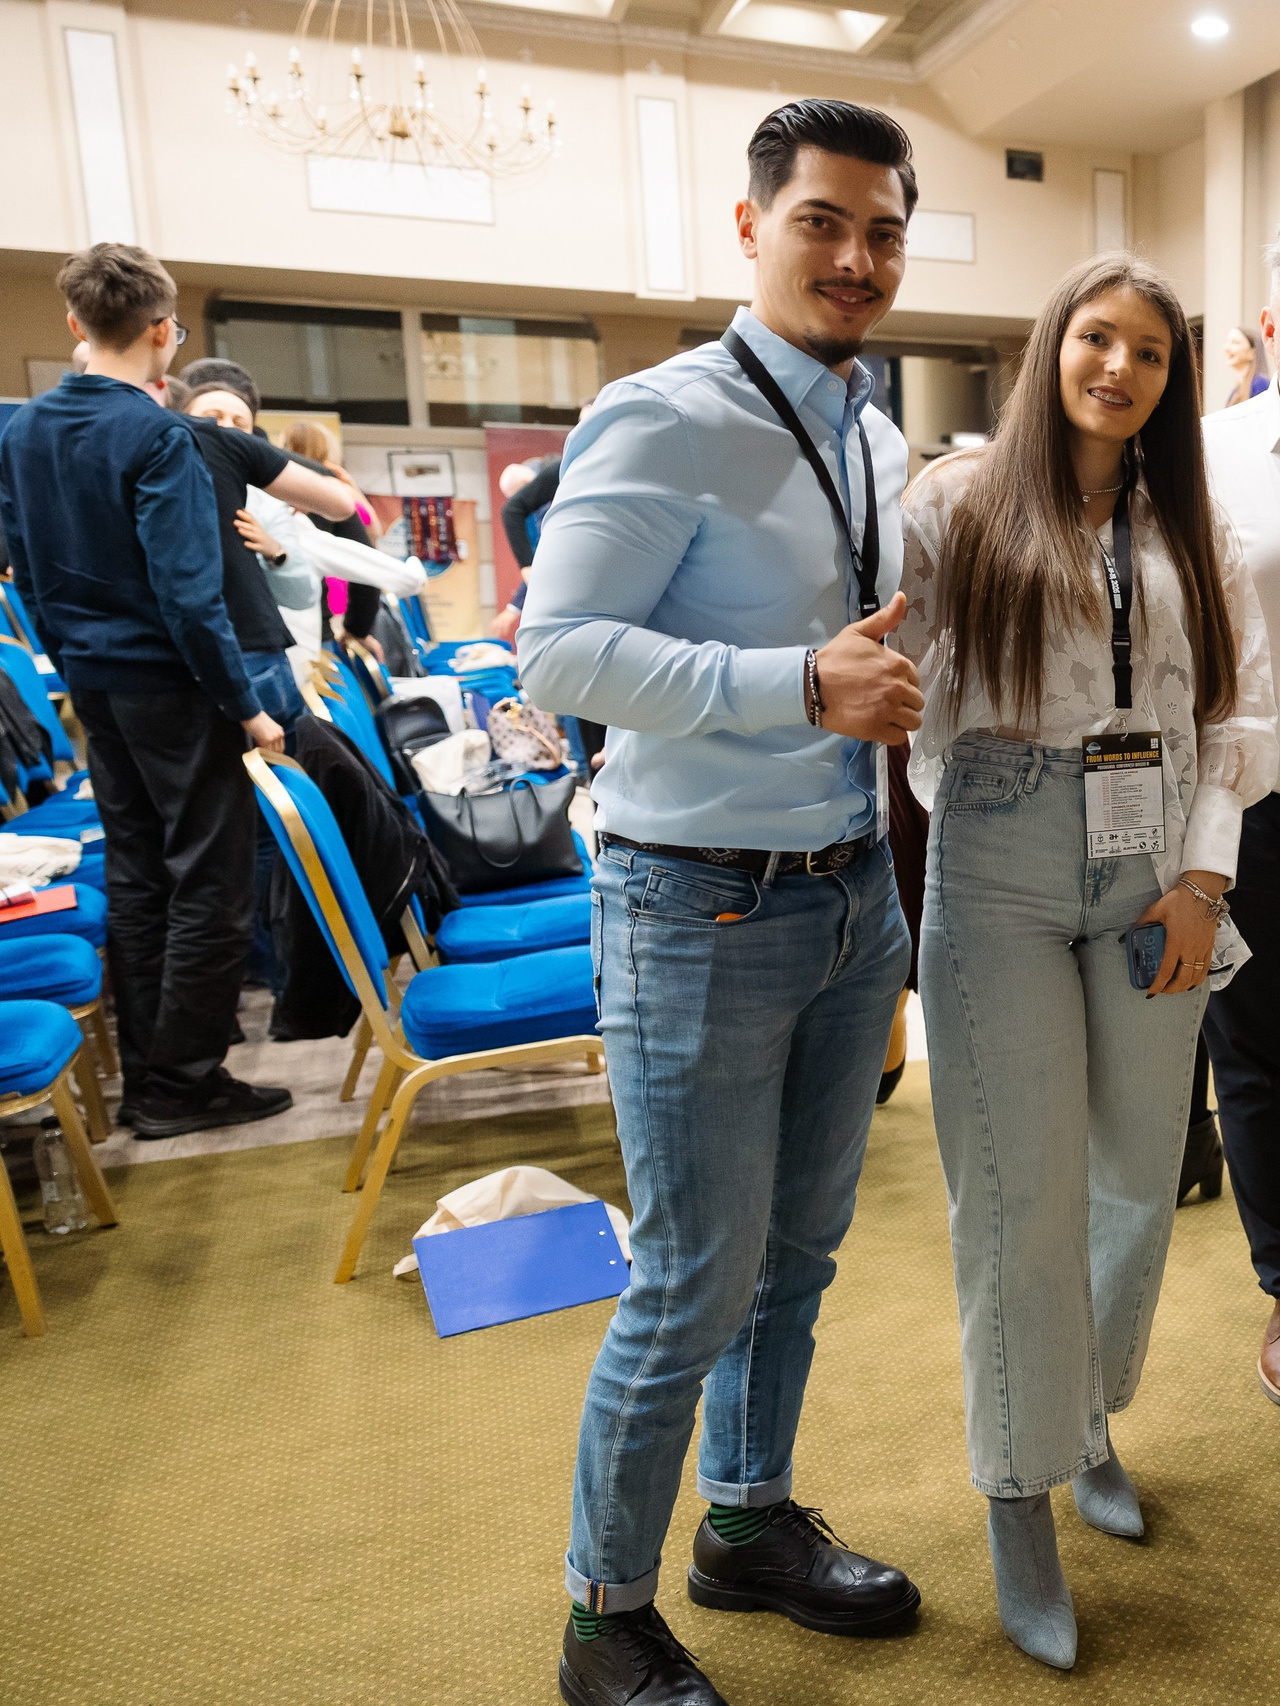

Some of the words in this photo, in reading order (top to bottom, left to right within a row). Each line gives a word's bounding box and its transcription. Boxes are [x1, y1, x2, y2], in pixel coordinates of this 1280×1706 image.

[1086, 754, 1103, 764] FROM
[1103, 752, 1123, 763] WORDS
[1124, 751, 1130, 761] TO
[1131, 749, 1160, 761] INFLUENCE
